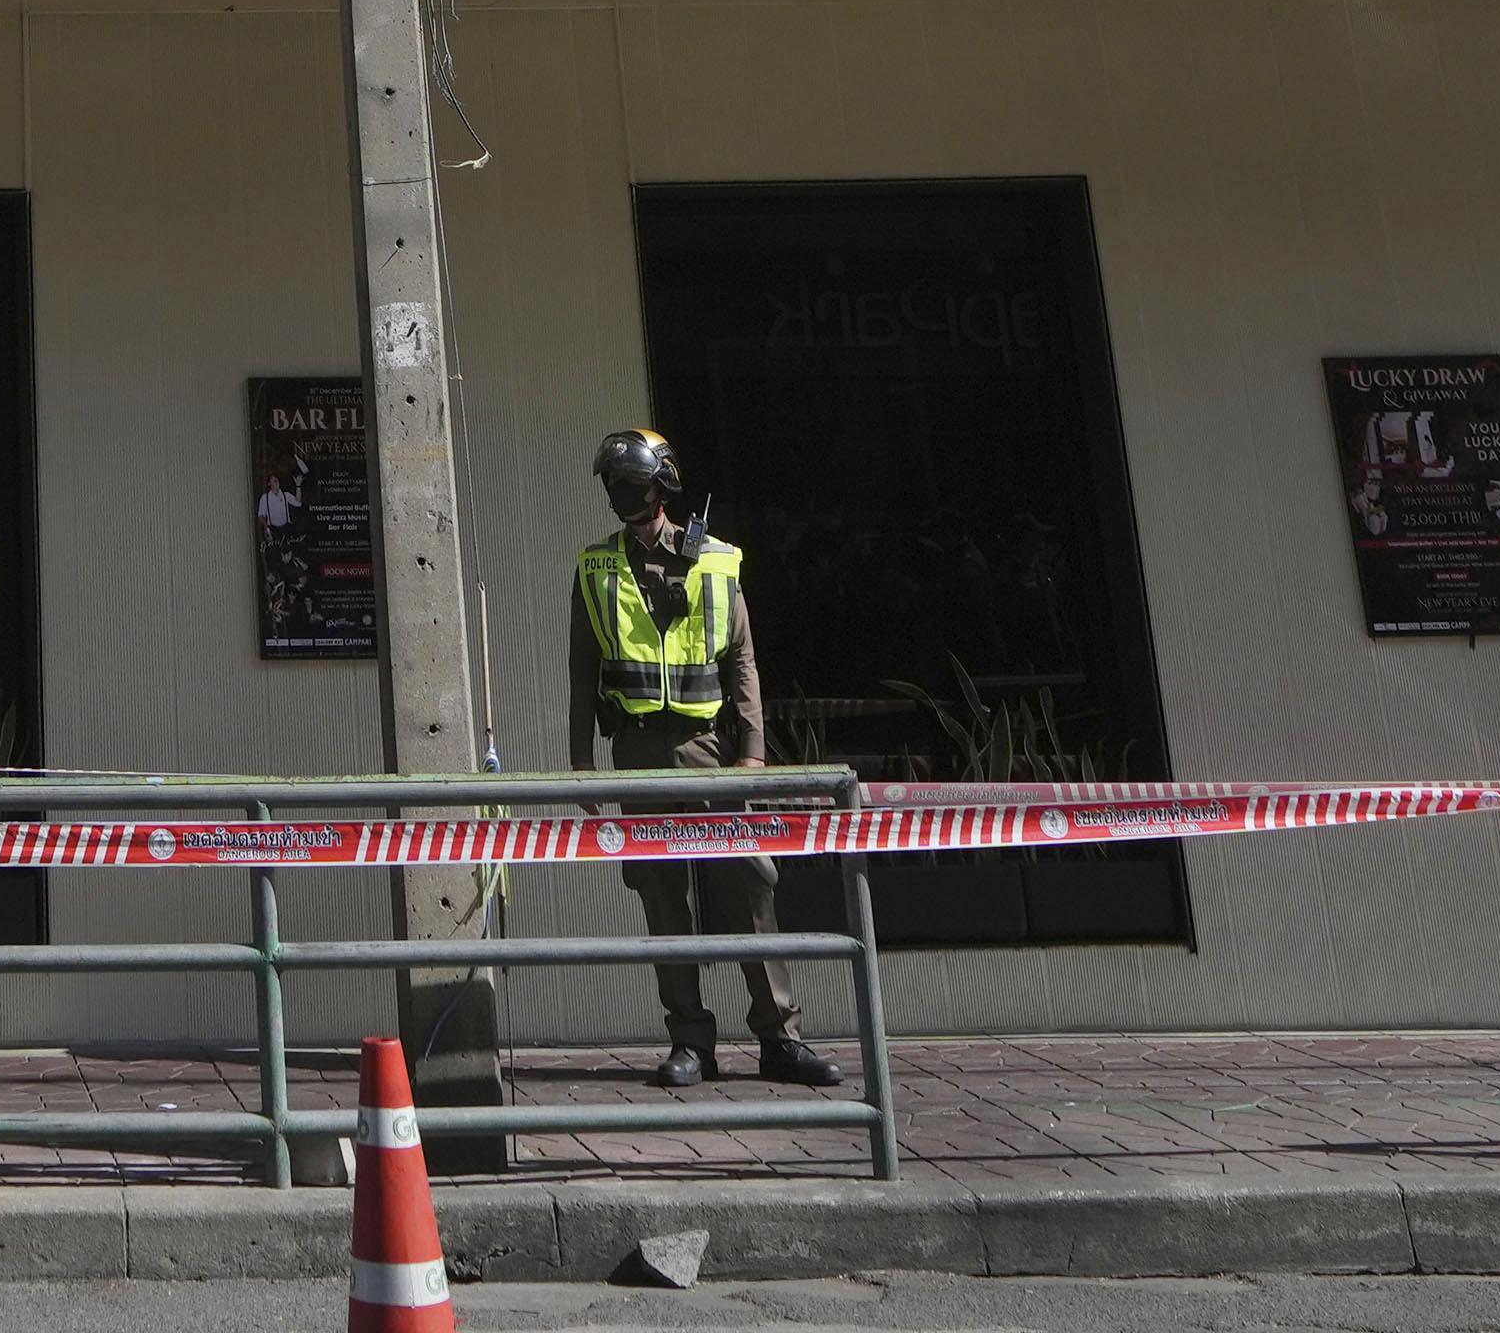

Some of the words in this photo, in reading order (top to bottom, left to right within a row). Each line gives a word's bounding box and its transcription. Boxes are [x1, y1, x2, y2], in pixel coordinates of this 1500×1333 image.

[1348, 369, 1417, 392] LUCKY
[1422, 367, 1486, 386] DRAW
[1403, 388, 1469, 404] GIVEAWAY
[270, 407, 328, 430] BAR
[293, 440, 323, 454] NEW
[585, 556, 618, 572] POLICE
[630, 814, 790, 842] เขตอันตรายห้ามเข้า
[183, 824, 342, 849] เขตอันตรายห้ามเข้า
[666, 840, 729, 853] DANGEROUS
[731, 839, 760, 851] AREA
[217, 850, 280, 861] DANGEROUS
[283, 850, 311, 860] AREA
